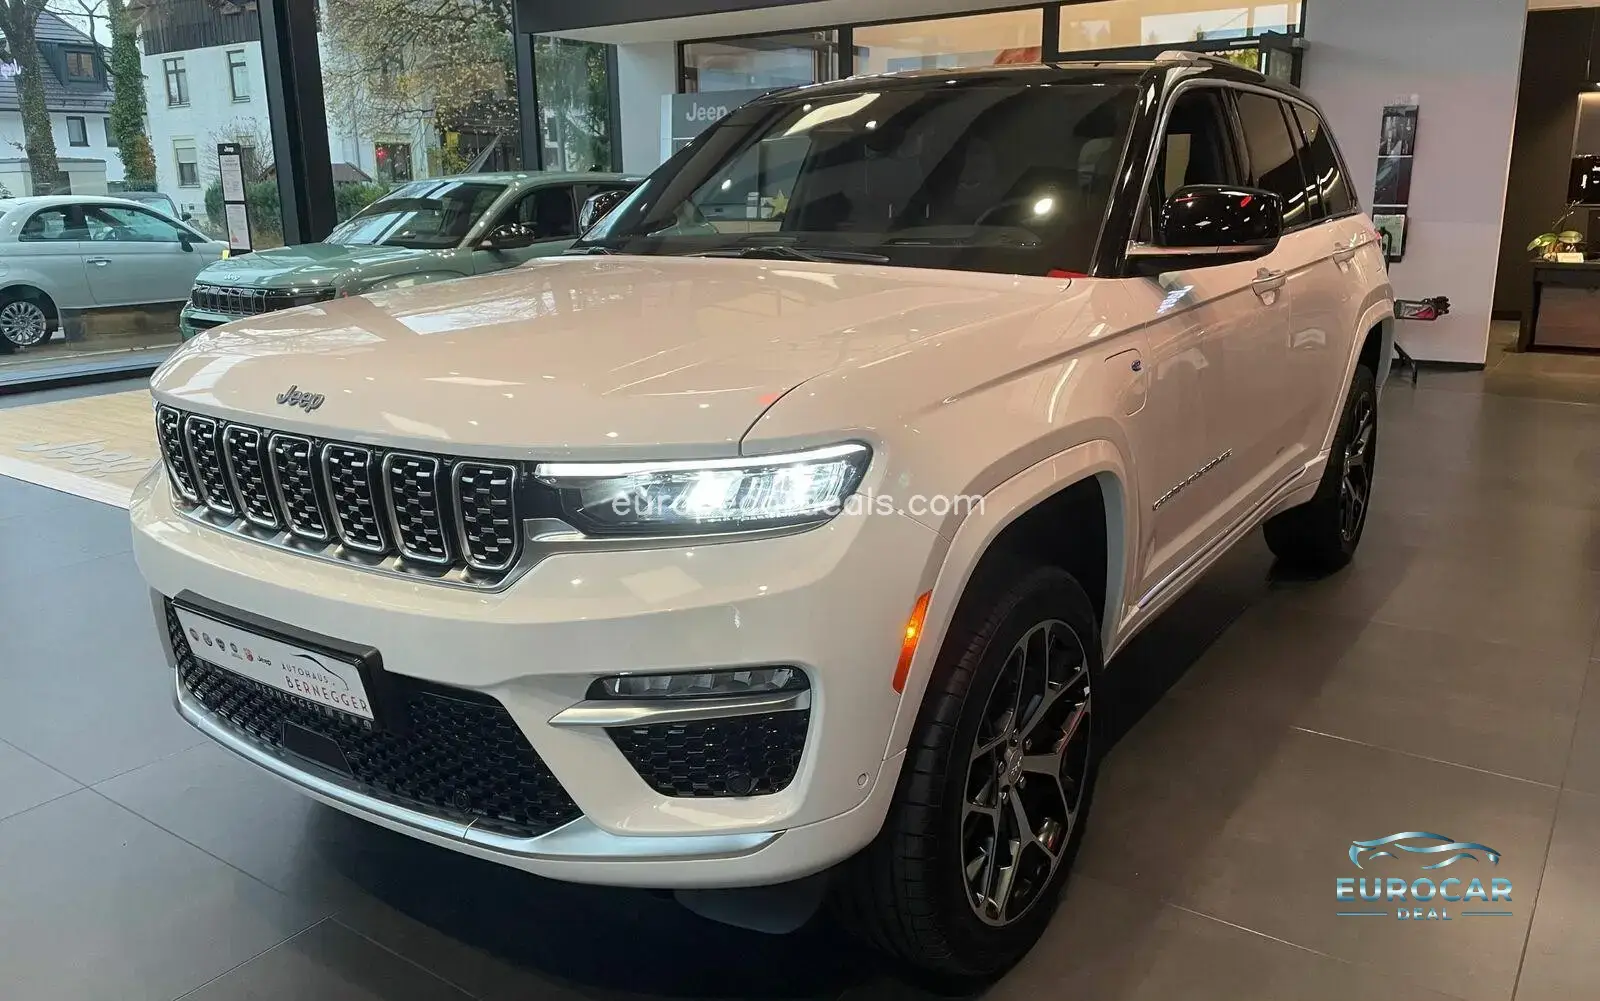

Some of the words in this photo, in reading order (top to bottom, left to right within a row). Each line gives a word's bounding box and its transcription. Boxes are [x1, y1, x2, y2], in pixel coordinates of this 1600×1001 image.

[686, 102, 728, 121] Jeep
[275, 384, 325, 413] Jeep
[281, 663, 330, 685] AUTOHAUS
[285, 675, 370, 713] BERNEGGER
